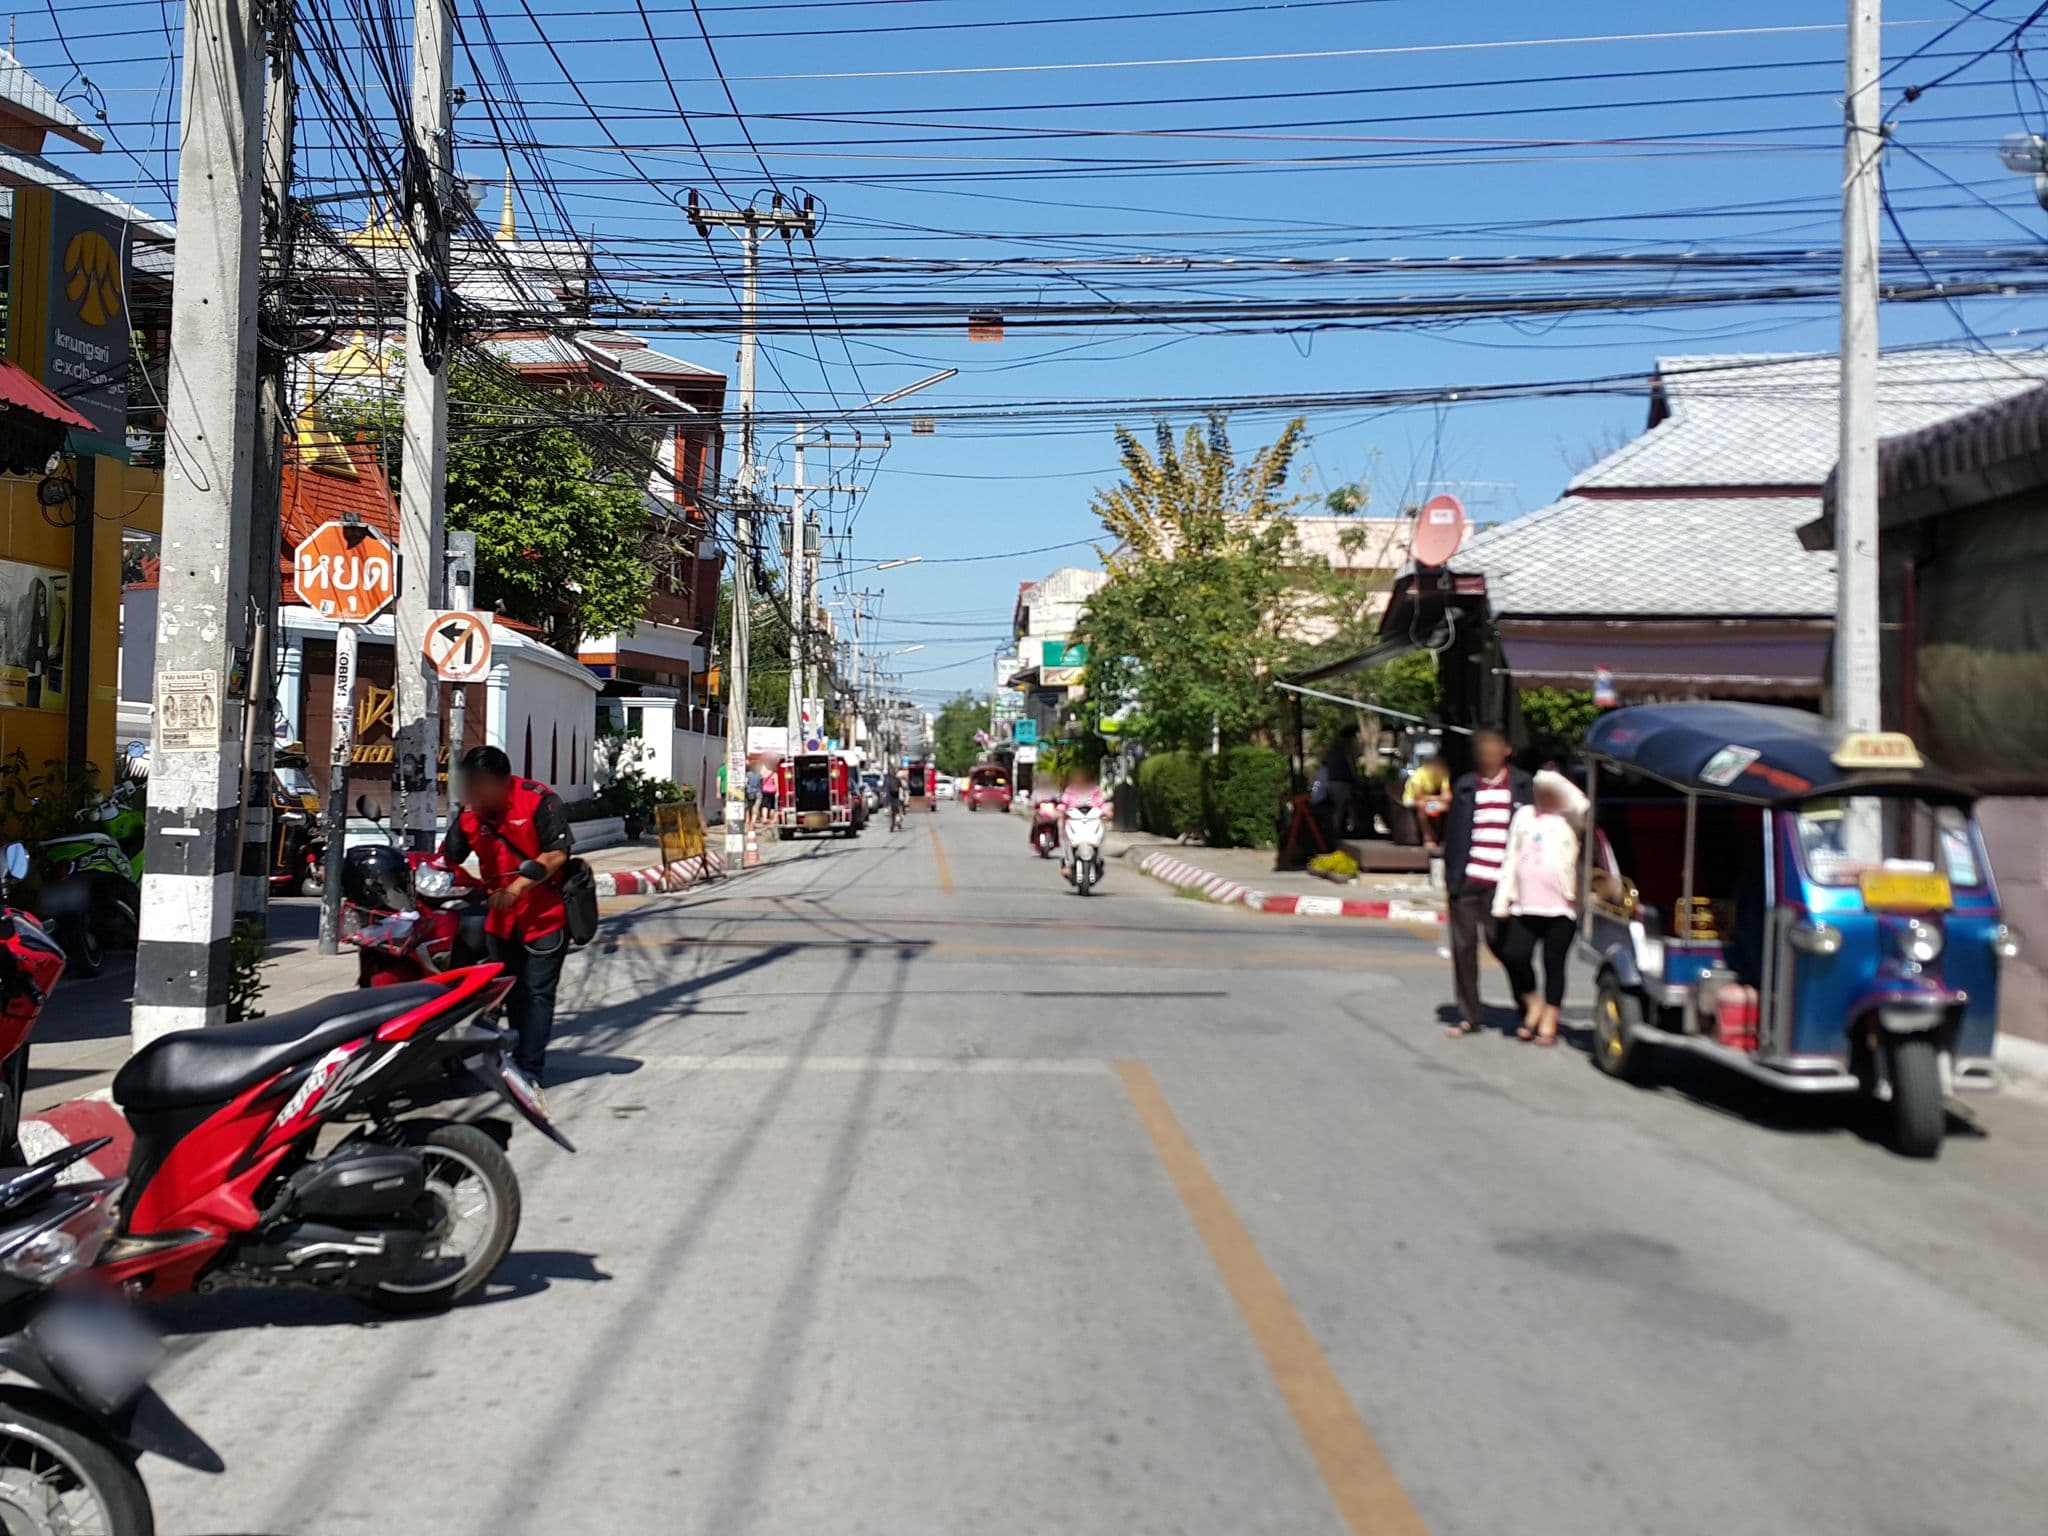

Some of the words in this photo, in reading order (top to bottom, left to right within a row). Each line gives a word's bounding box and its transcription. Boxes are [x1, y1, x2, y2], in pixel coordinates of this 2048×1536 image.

[54, 327, 110, 364] krungsri
[301, 554, 389, 611] หยุด
[1859, 740, 1905, 756] TAXI
